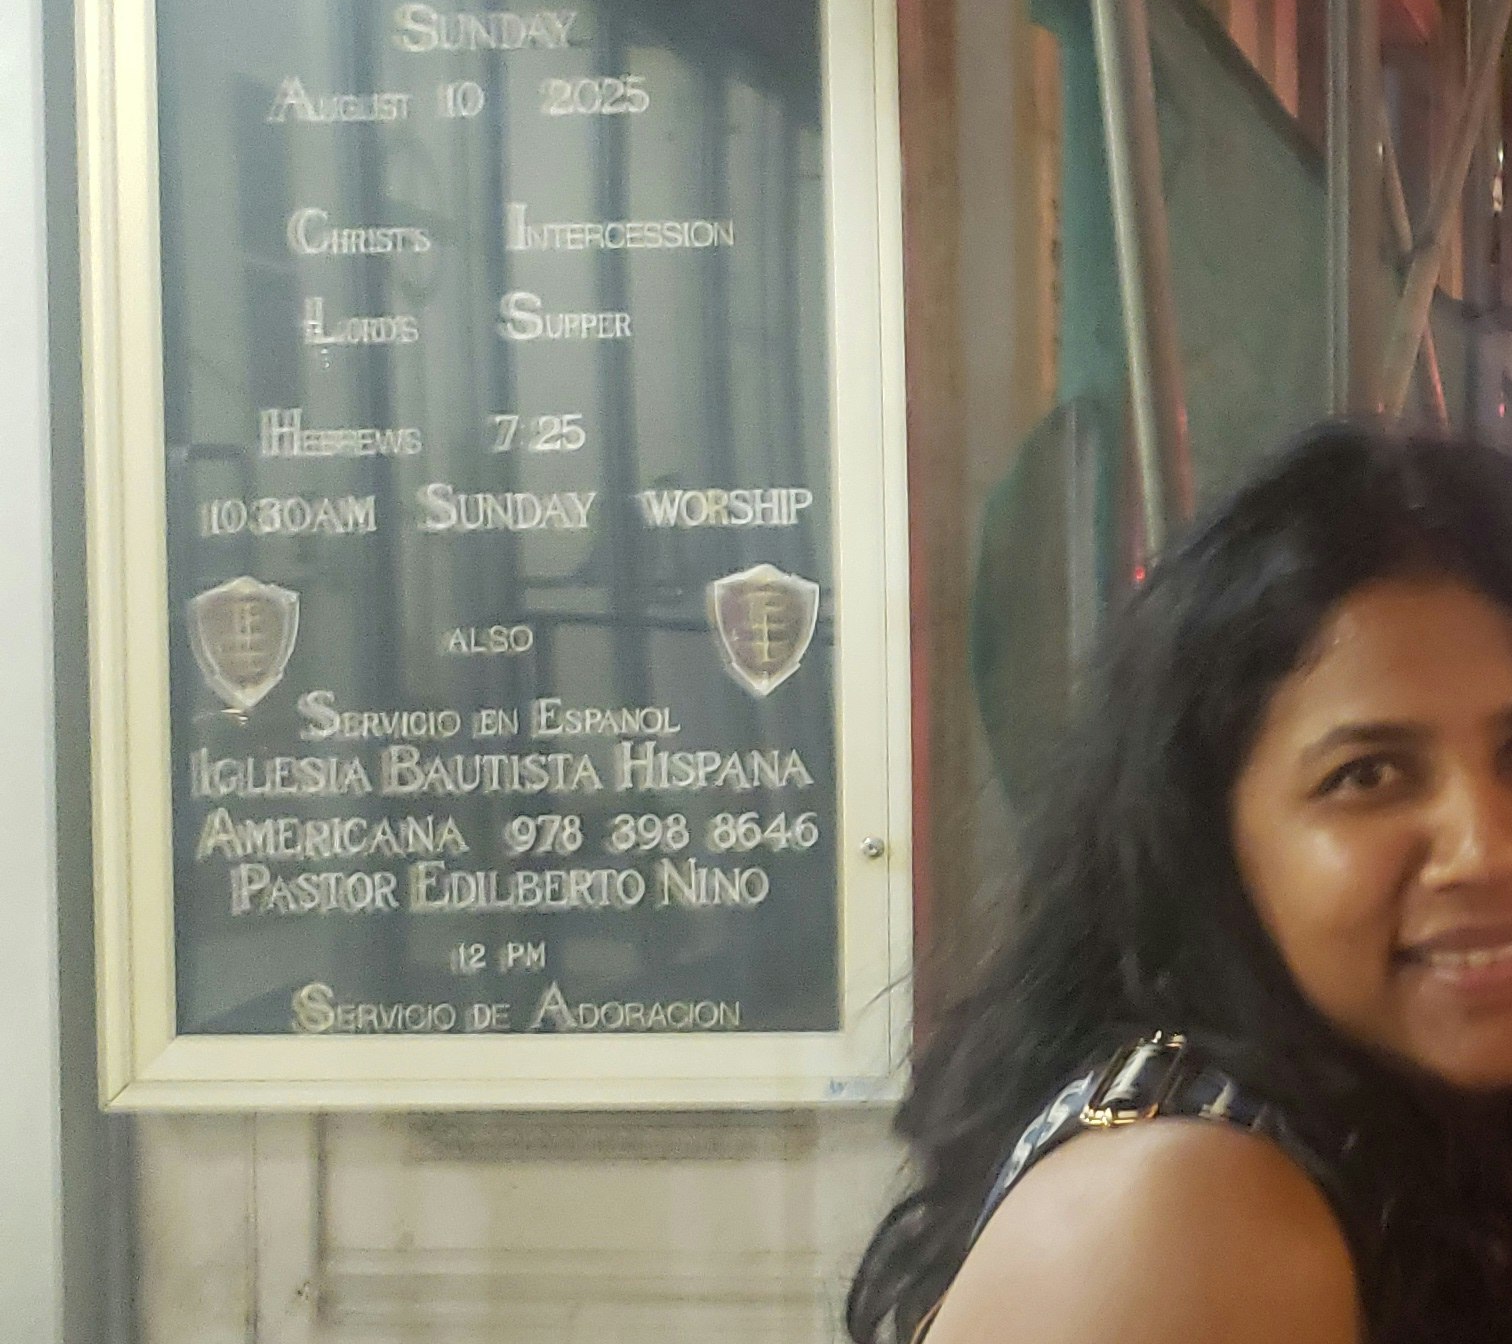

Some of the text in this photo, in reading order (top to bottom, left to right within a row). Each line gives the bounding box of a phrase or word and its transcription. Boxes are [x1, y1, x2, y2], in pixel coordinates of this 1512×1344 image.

[397, 2, 577, 53] SUNDAY
[437, 78, 486, 119] 10
[538, 74, 650, 116] 2025
[506, 201, 736, 252] INTERCESSION
[500, 291, 633, 341] SUPPER
[416, 482, 598, 532] SUNDAY
[637, 487, 813, 529] WORSHIP
[448, 624, 534, 654] ALSO
[298, 690, 682, 739] SERVICIO EN ESPANOL
[190, 739, 815, 797] IGLESIA BAUTISTA HISPANA
[197, 807, 820, 859] AMERICANA 978 398 8646
[230, 856, 770, 916] PASTOR EDILBERTO NINO
[453, 940, 547, 974] 12 PM
[291, 980, 741, 1034] SERVICIO DE ADORACION
